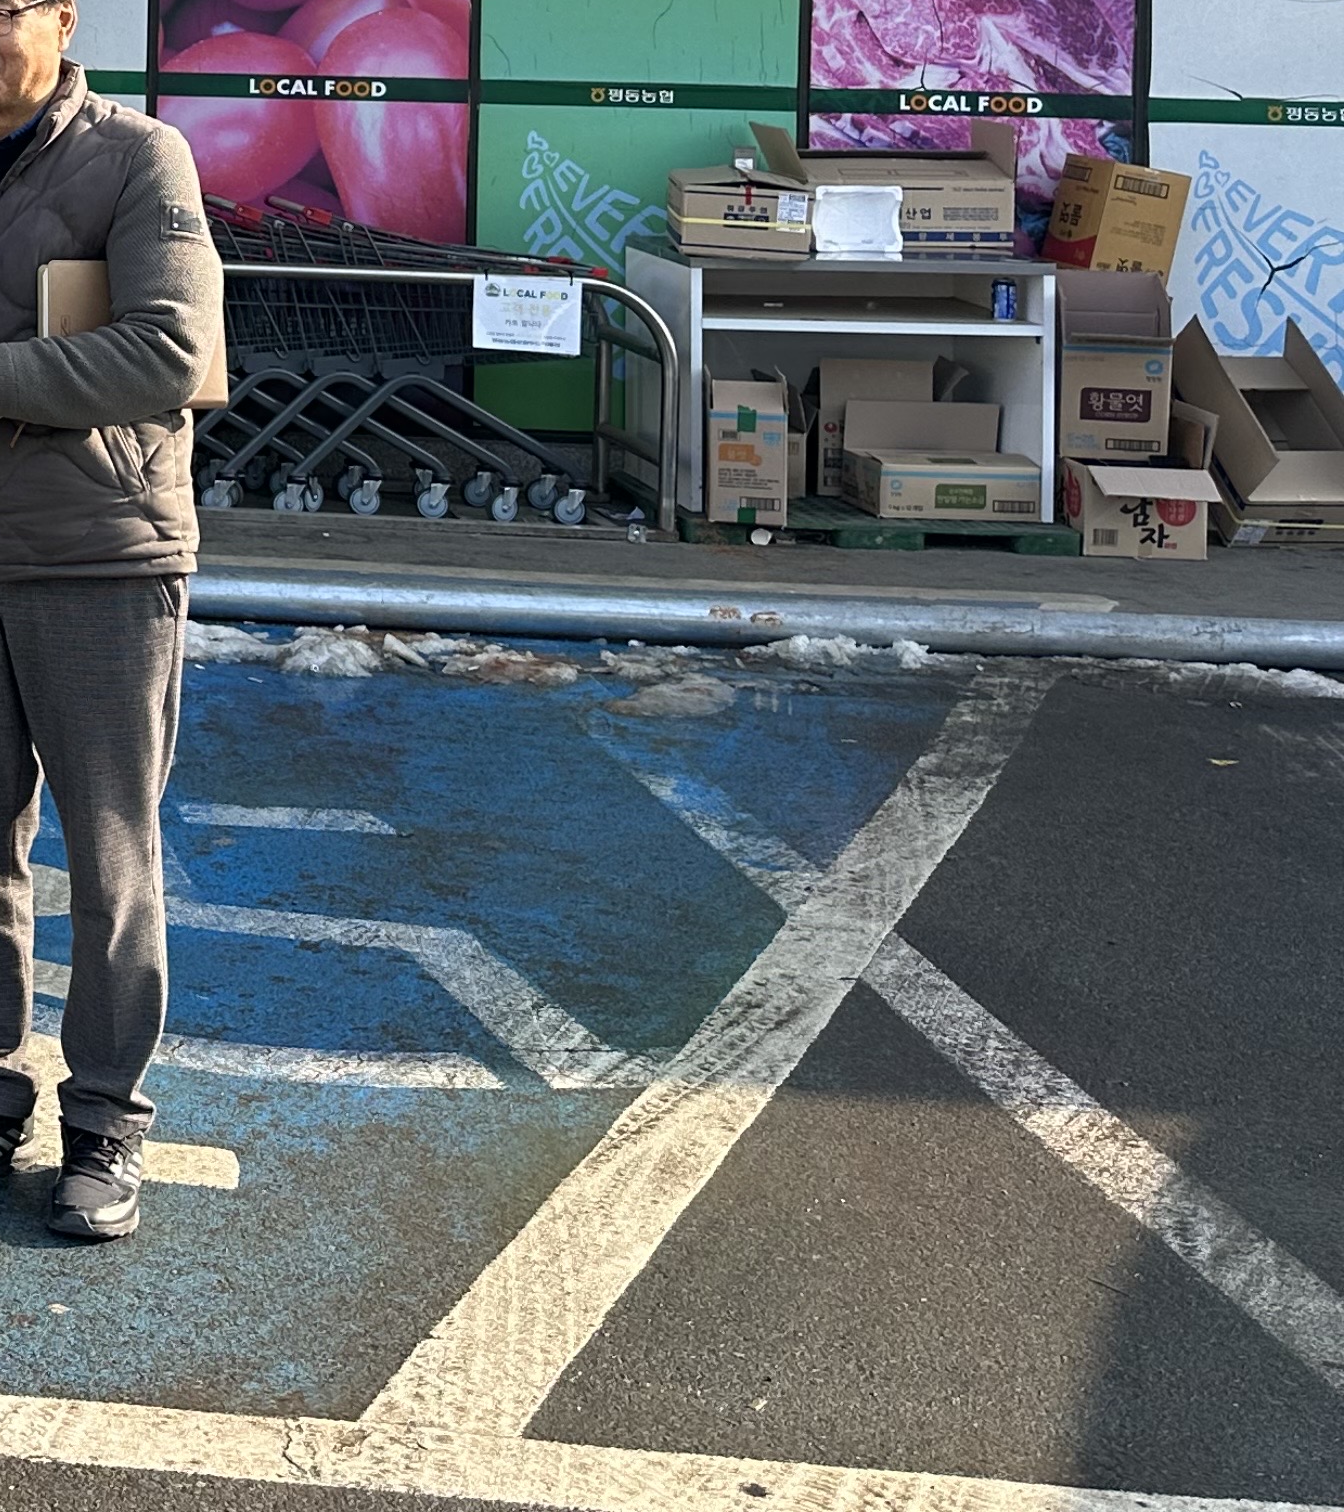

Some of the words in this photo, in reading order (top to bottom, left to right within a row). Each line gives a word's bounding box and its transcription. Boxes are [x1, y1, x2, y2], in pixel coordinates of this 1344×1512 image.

[249, 78, 318, 97] LOCAL
[324, 79, 387, 98] FOOD
[609, 87, 675, 105] 평동농협
[899, 93, 970, 113] LOCAL
[978, 94, 1043, 114] FOOD
[1087, 391, 1144, 413] 황물엿
